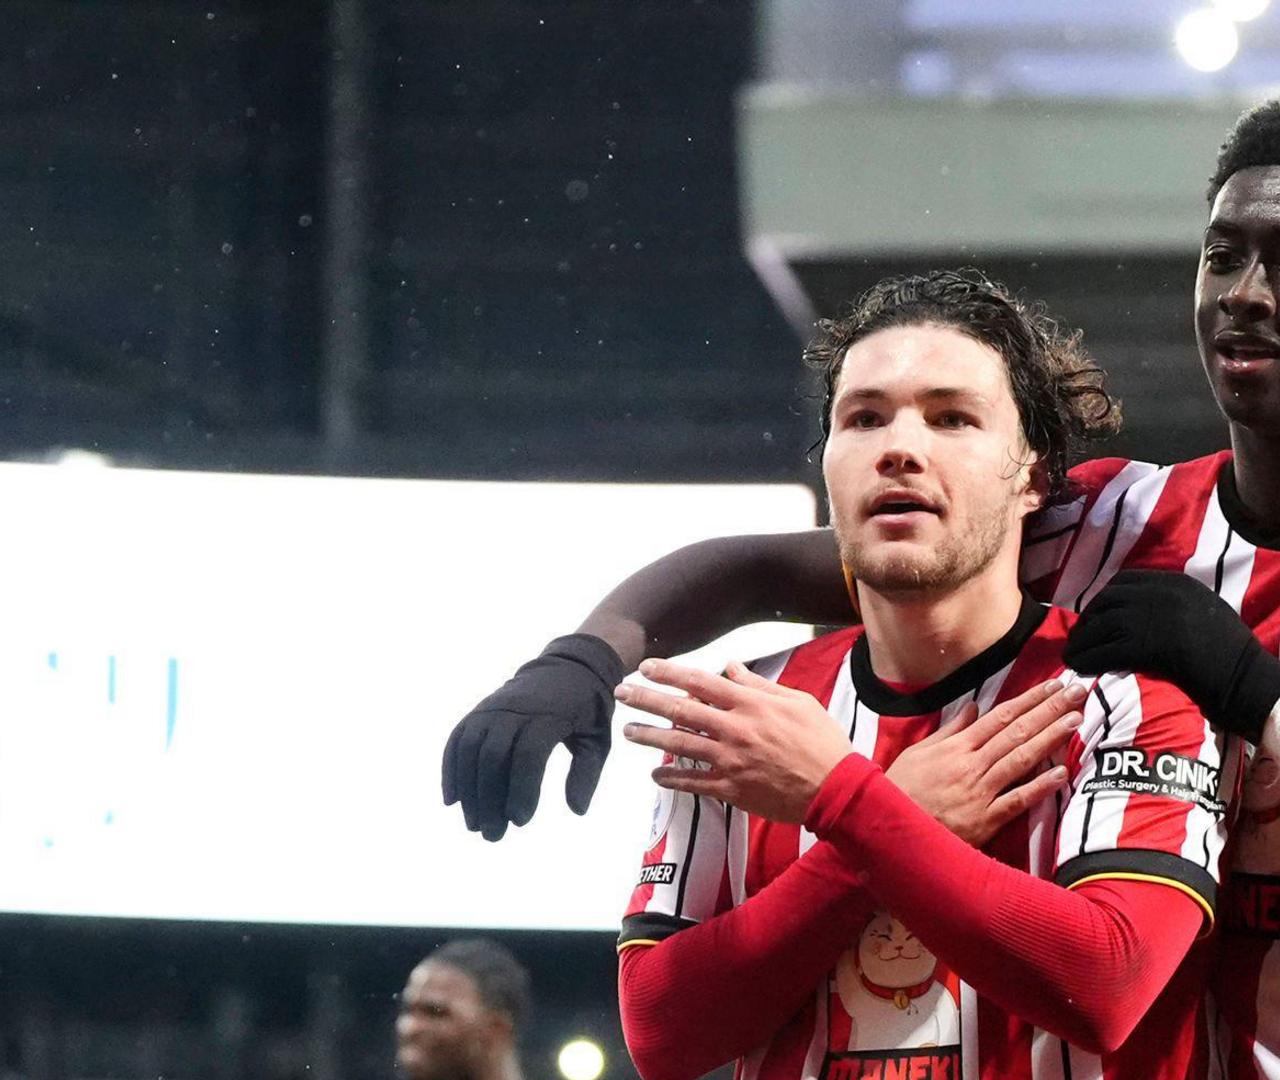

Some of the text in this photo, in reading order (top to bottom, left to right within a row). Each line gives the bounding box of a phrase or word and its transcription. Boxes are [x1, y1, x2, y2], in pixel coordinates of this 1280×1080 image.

[1101, 750, 1150, 777] DR.
[1084, 778, 1116, 791] Plastic
[1119, 779, 1160, 793] Surgery
